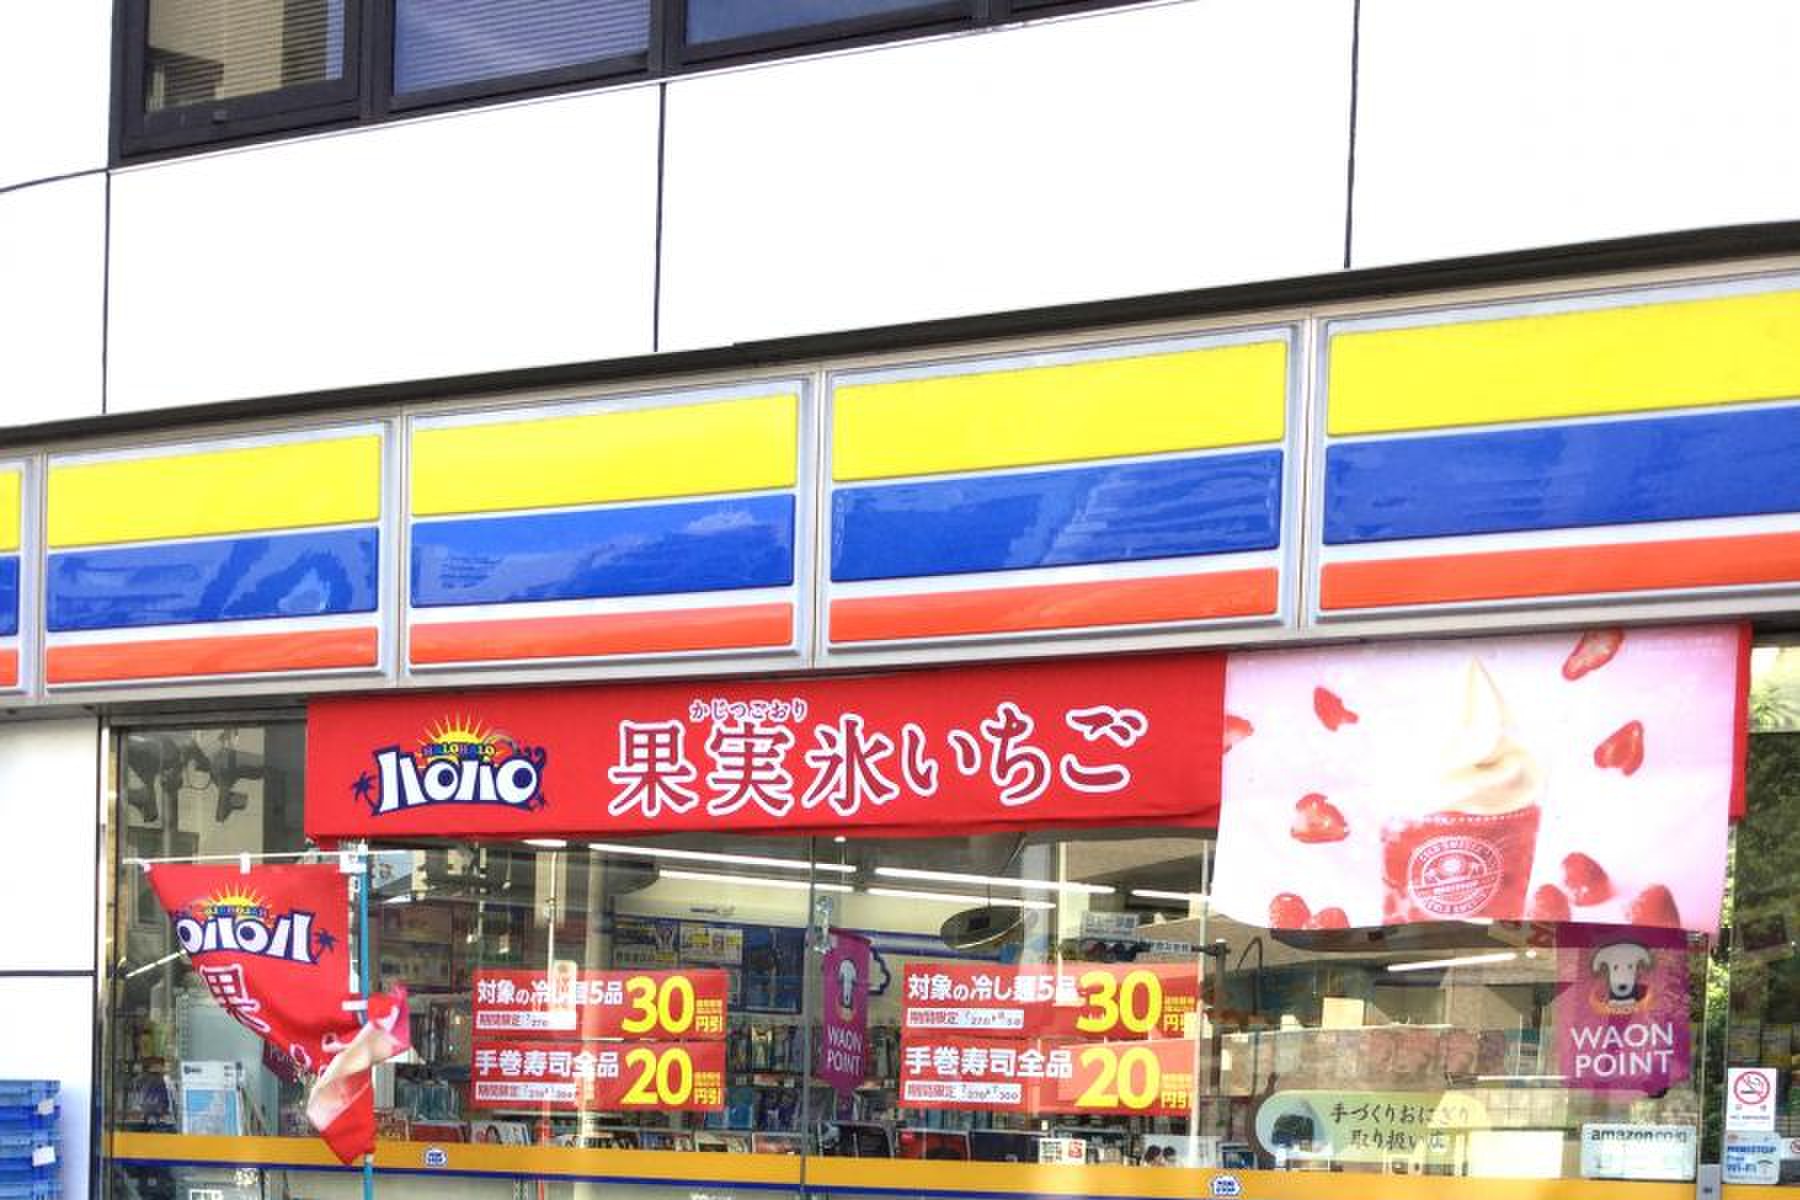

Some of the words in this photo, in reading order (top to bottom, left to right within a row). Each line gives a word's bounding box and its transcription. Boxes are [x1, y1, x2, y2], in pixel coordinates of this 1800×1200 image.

[689, 699, 808, 722] かじつごおり
[608, 703, 1148, 816] 果実氷いちご
[827, 1026, 862, 1051] WAON
[1571, 1023, 1674, 1049] WAON
[475, 1049, 619, 1078] 手巻寿司全品
[827, 1051, 862, 1075] POINT
[905, 1046, 1073, 1078] 手巻寿司全品
[1575, 1050, 1674, 1078] POINT
